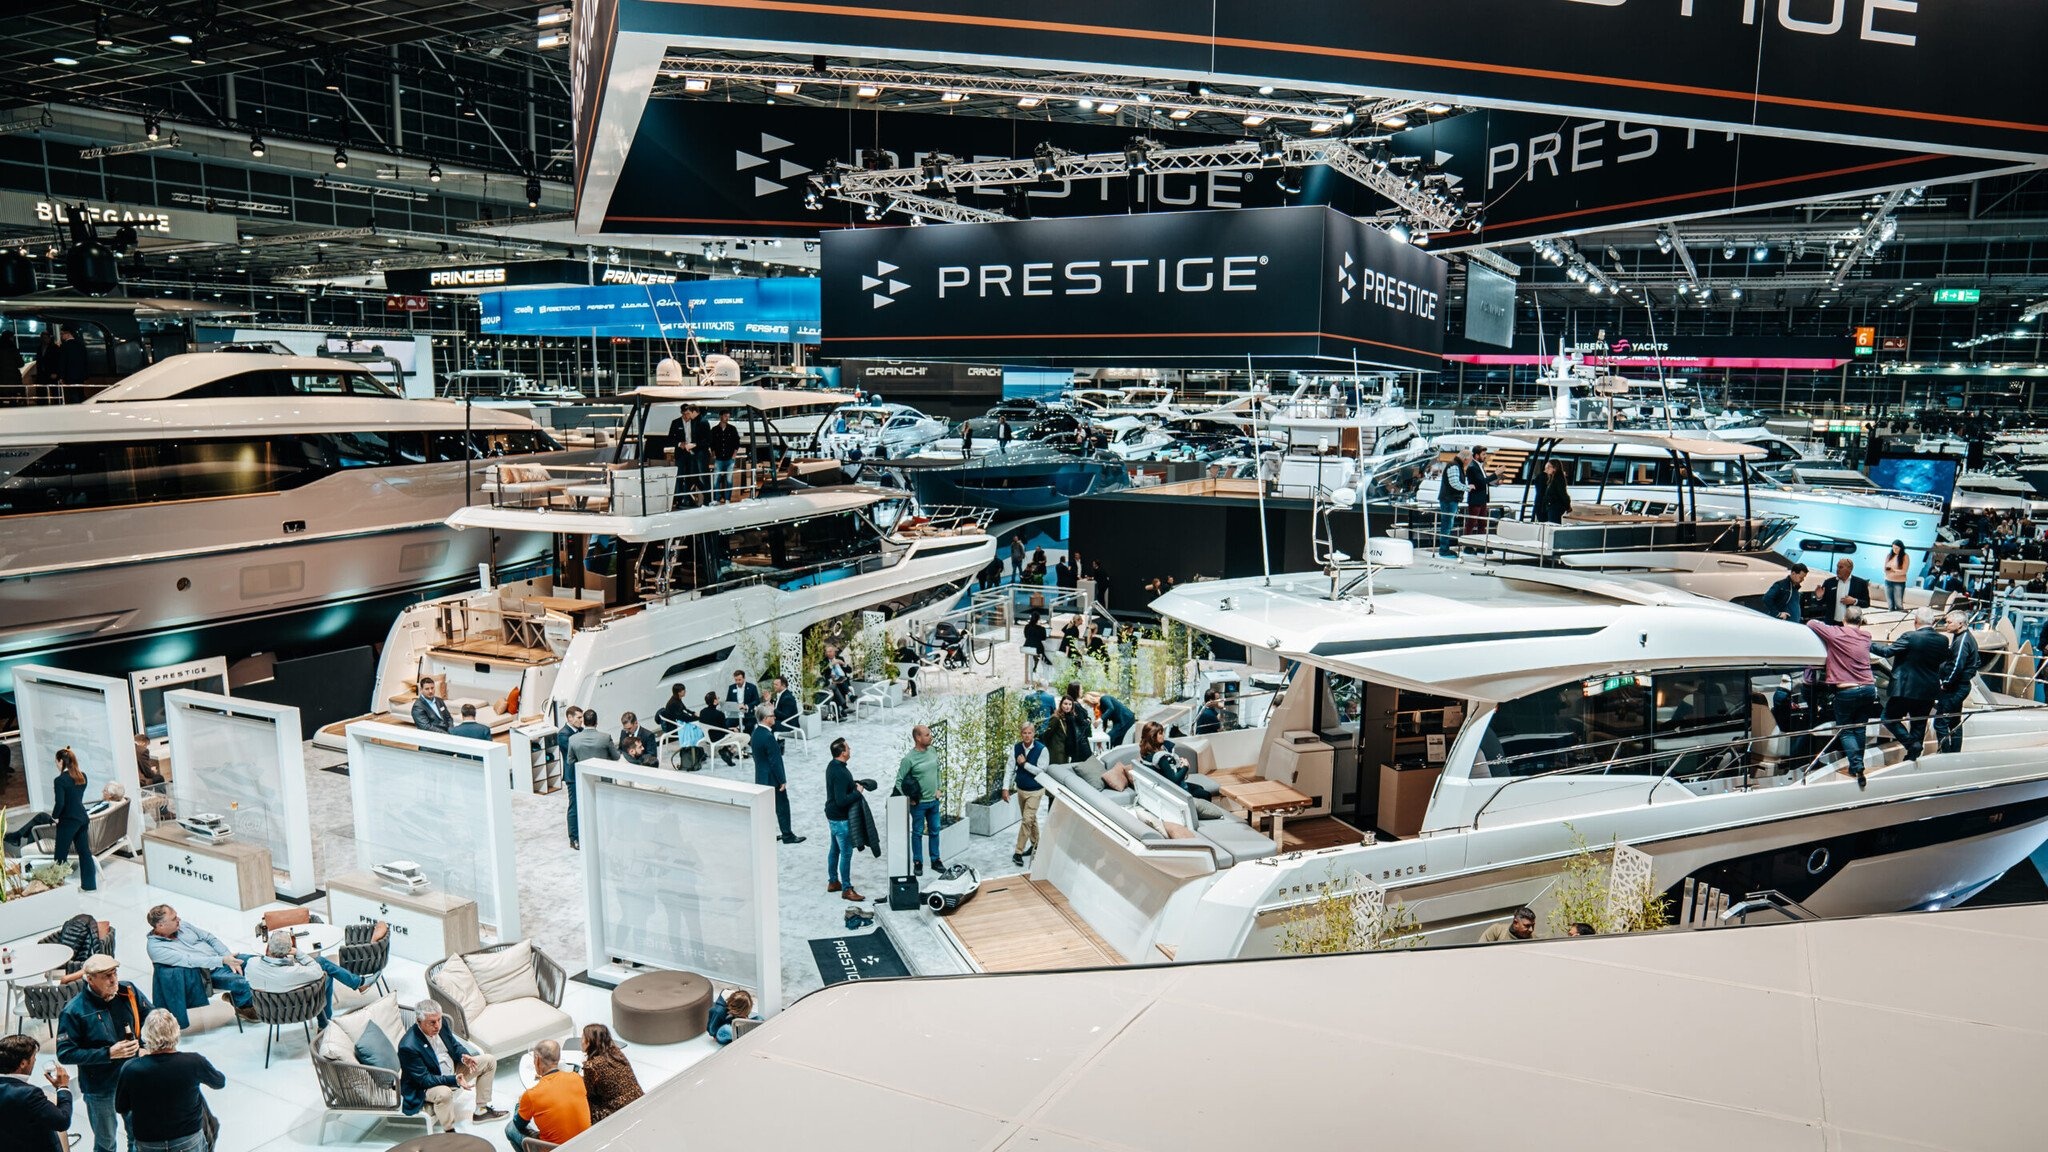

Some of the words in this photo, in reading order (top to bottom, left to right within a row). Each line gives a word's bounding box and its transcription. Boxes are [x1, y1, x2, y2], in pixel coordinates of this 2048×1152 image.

[36, 202, 170, 232] BLEGAME
[430, 269, 506, 286] PRINCESS
[602, 269, 677, 285] PRINCESS
[1363, 268, 1438, 320] PRESTIGE
[745, 323, 789, 334] PERSHING
[1859, 332, 1868, 345] 6
[1575, 342, 1609, 351] SIRENA
[1632, 343, 1668, 351] YACHTS
[866, 367, 926, 376] CRANCHI
[967, 367, 1001, 376] CRANCHI
[155, 667, 207, 681] PRESTIGE
[168, 864, 214, 883] PRESTIGE
[360, 915, 408, 935] PRETIGE
